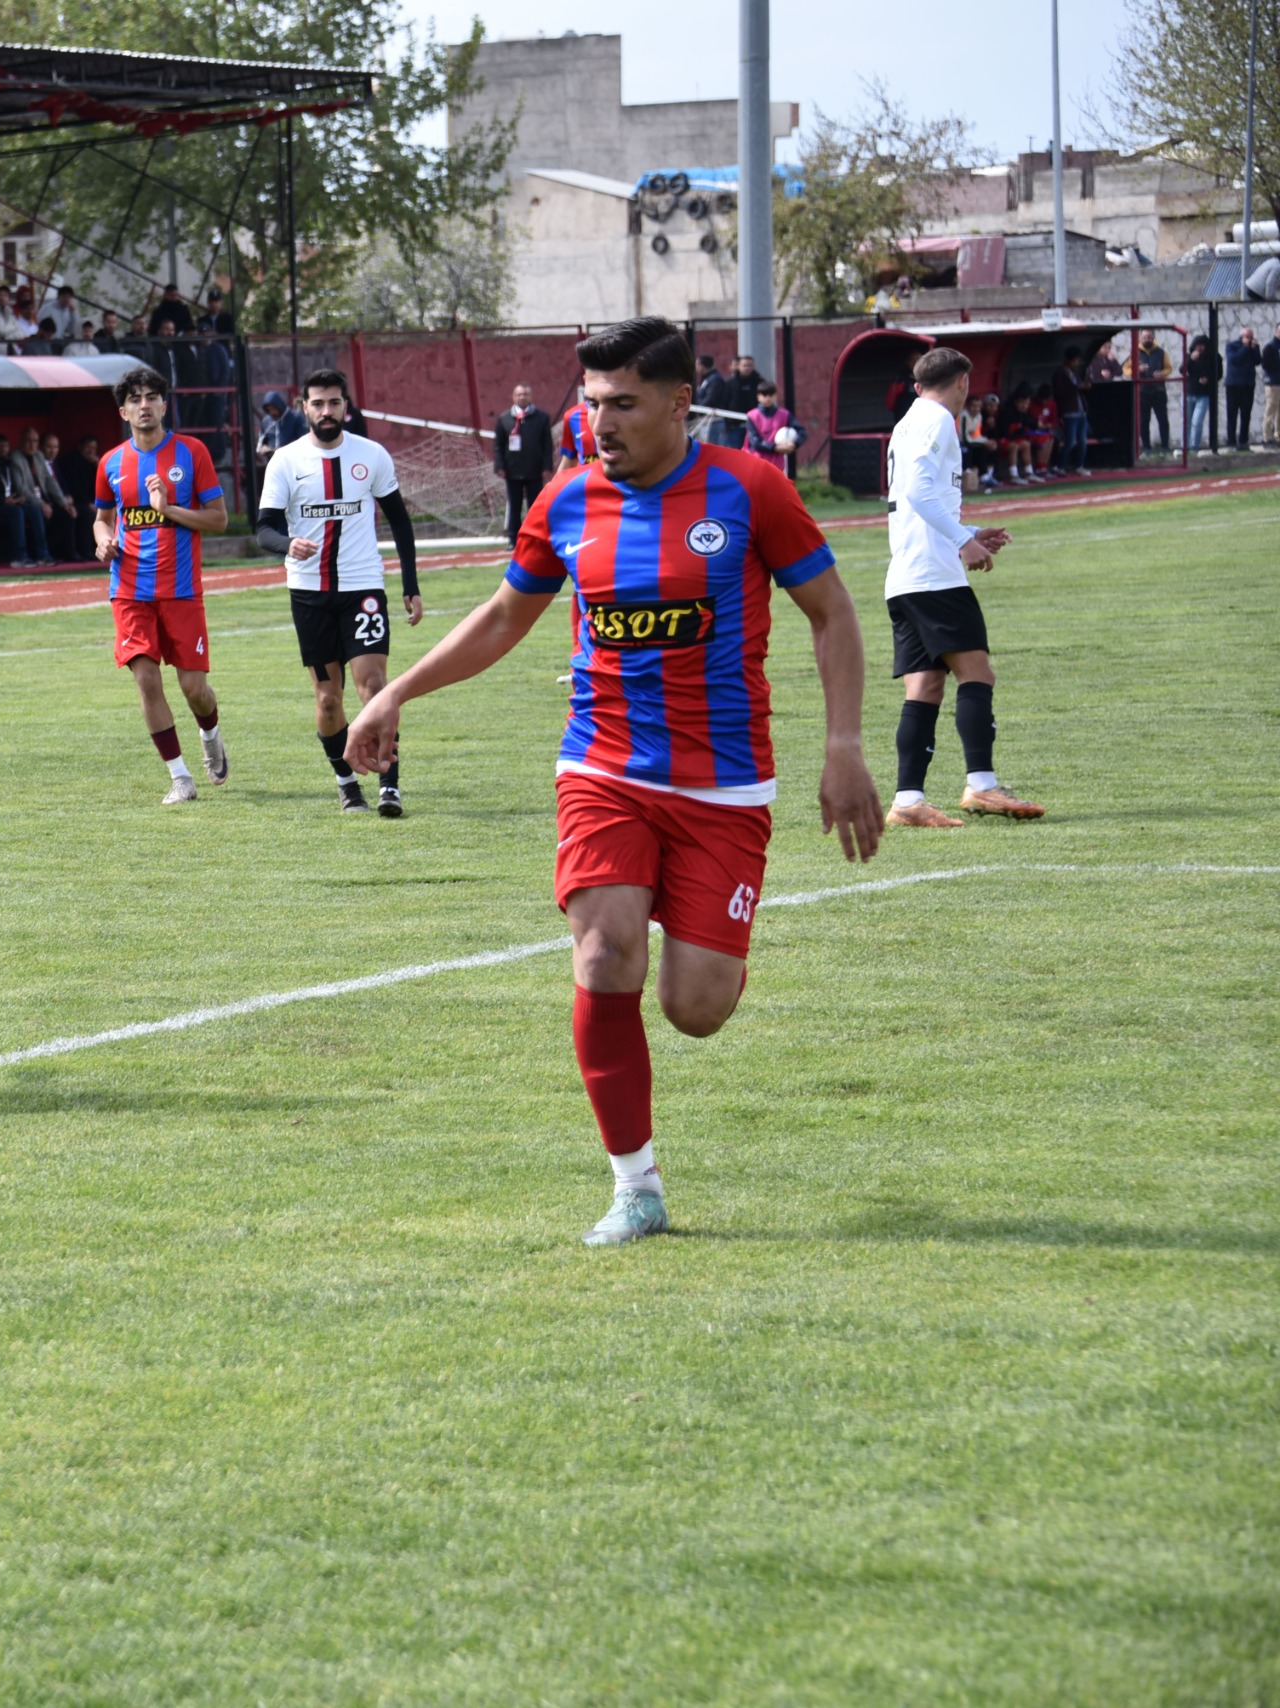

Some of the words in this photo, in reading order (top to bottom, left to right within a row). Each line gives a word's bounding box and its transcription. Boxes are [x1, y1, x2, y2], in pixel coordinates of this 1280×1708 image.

[303, 505, 331, 518] Green
[354, 612, 386, 640] 23
[195, 636, 205, 656] 4
[727, 883, 754, 923] 63
